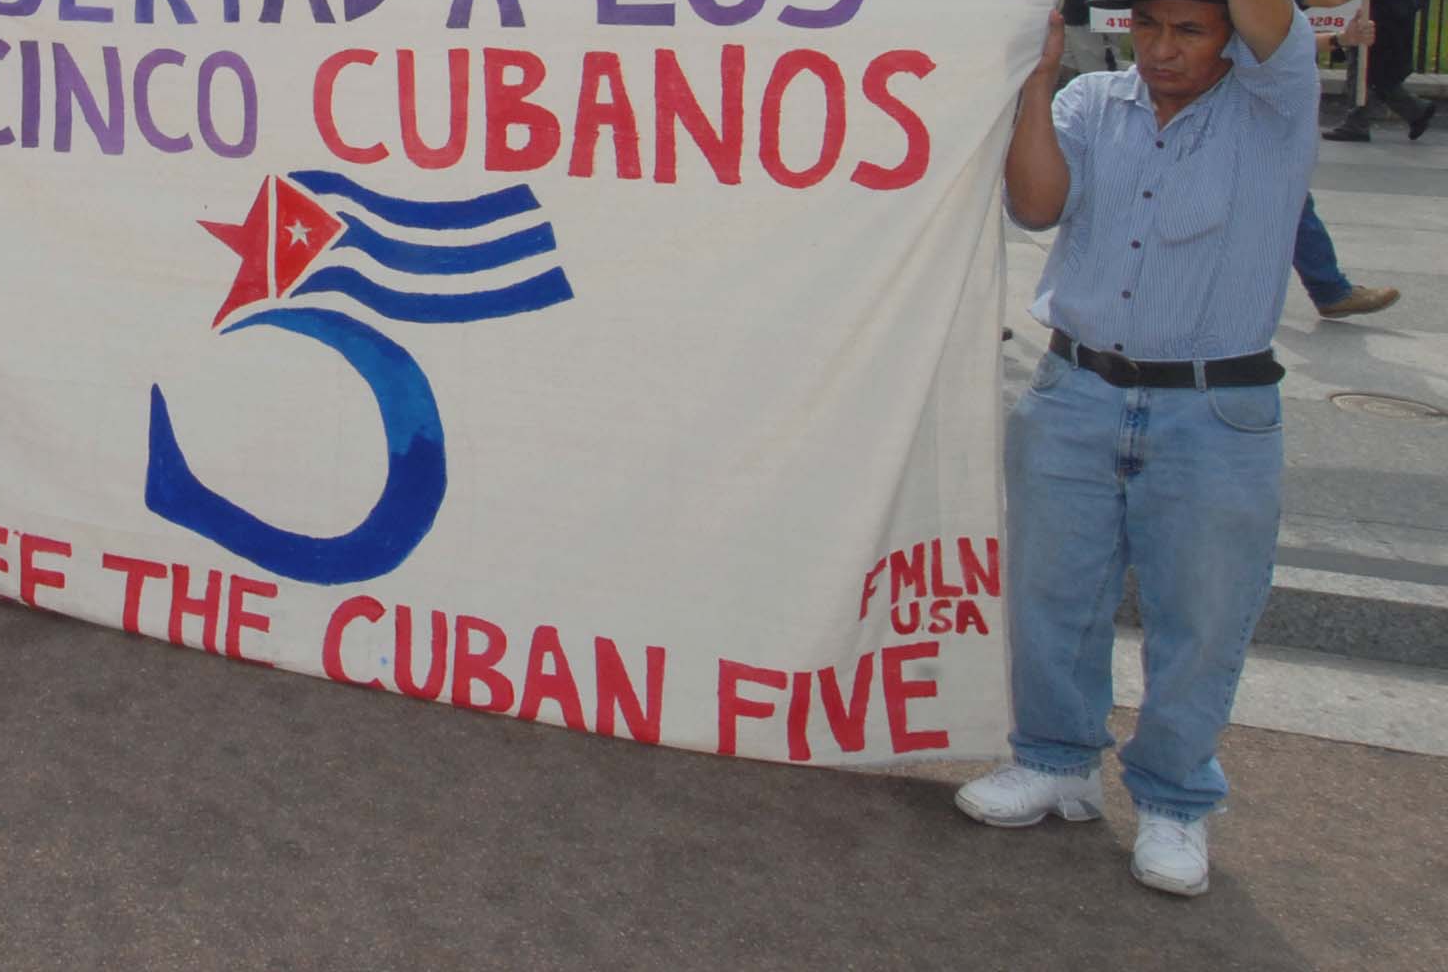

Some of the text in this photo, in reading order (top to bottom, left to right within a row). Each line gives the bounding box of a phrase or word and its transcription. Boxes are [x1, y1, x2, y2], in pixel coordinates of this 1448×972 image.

[312, 43, 938, 191] CUBANOS
[859, 536, 1002, 622] FMLN
[890, 598, 990, 636] USA
[101, 552, 279, 669] THE
[321, 594, 666, 747] CUBAN
[717, 640, 950, 763] FIVE
